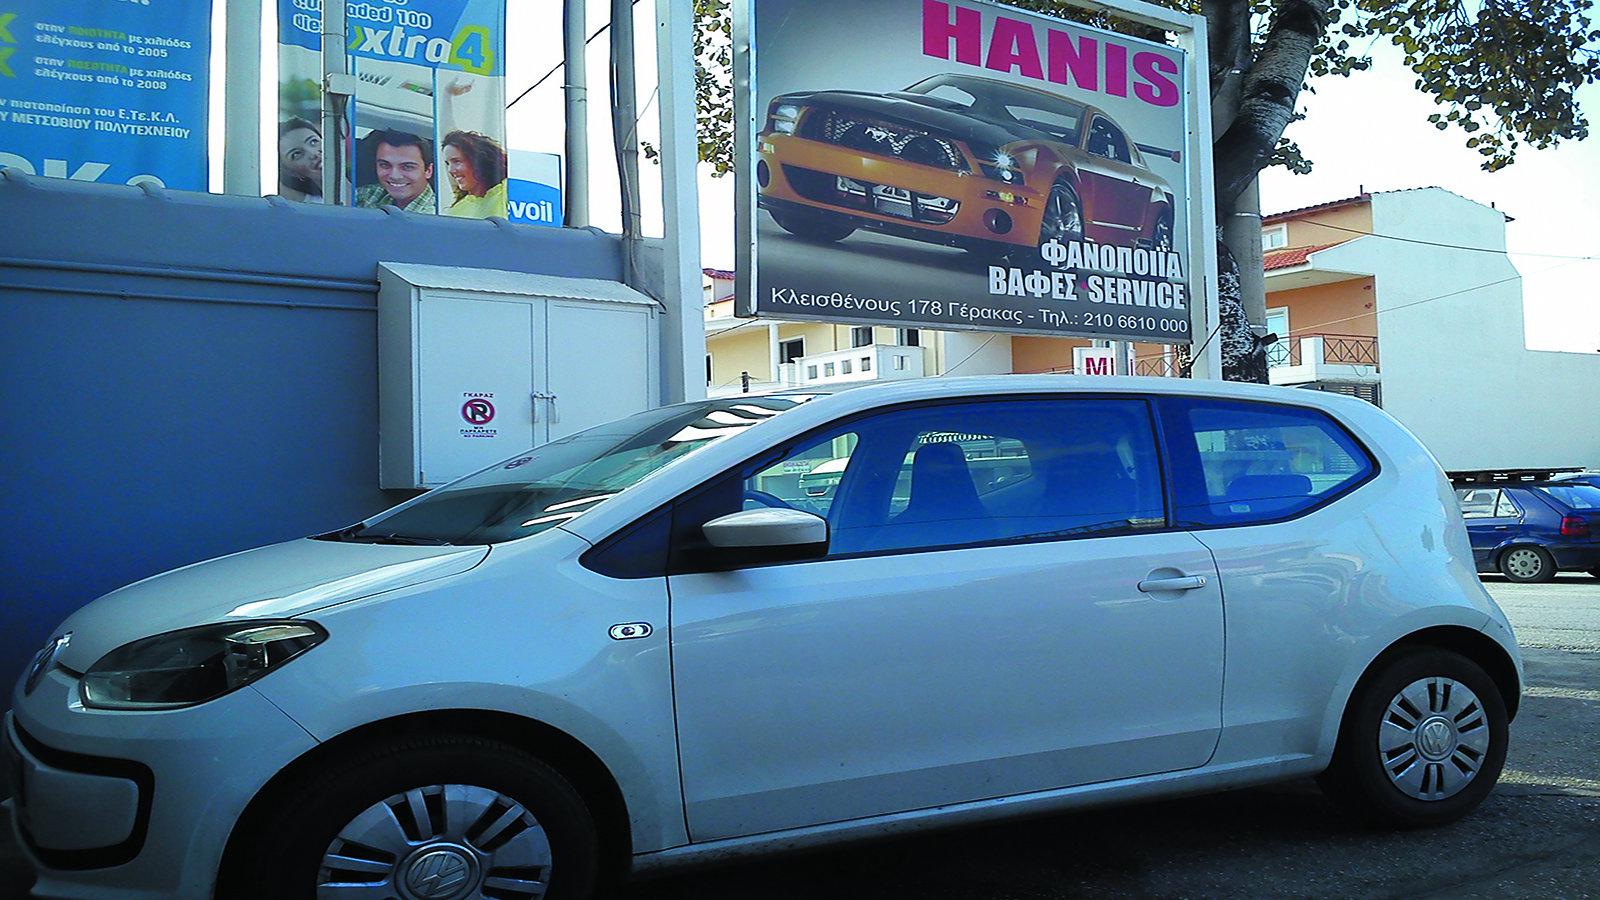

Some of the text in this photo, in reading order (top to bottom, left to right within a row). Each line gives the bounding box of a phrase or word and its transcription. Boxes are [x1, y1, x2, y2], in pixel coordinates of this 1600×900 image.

[396, 9, 432, 29] 100
[35, 34, 168, 58] ελέγχους από το 2005
[129, 33, 142, 44] με
[144, 36, 192, 49] χιλιάδες
[922, 0, 1180, 107] HANIS
[35, 68, 167, 90] ελέγχους από το 2008
[129, 67, 143, 78] με
[145, 69, 193, 82] χιλιάδες
[94, 107, 116, 117] του
[12, 112, 91, 130] ΜΕΤΣΟΒΙΟΥ
[95, 120, 190, 139] ΠΟΛΥΤΕΧΝΕΙΟΥ
[506, 200, 553, 223] voil
[988, 265, 1187, 311] ΒΑΦΕΣ SERVICE
[771, 287, 901, 316] Κλεισθένους
[908, 299, 943, 316] 178
[948, 302, 1023, 325] Γέρακας
[1038, 308, 1079, 326] Τηλ.:
[1083, 312, 1114, 328] 210
[1117, 314, 1156, 331] 6610
[1160, 318, 1188, 333] 000
